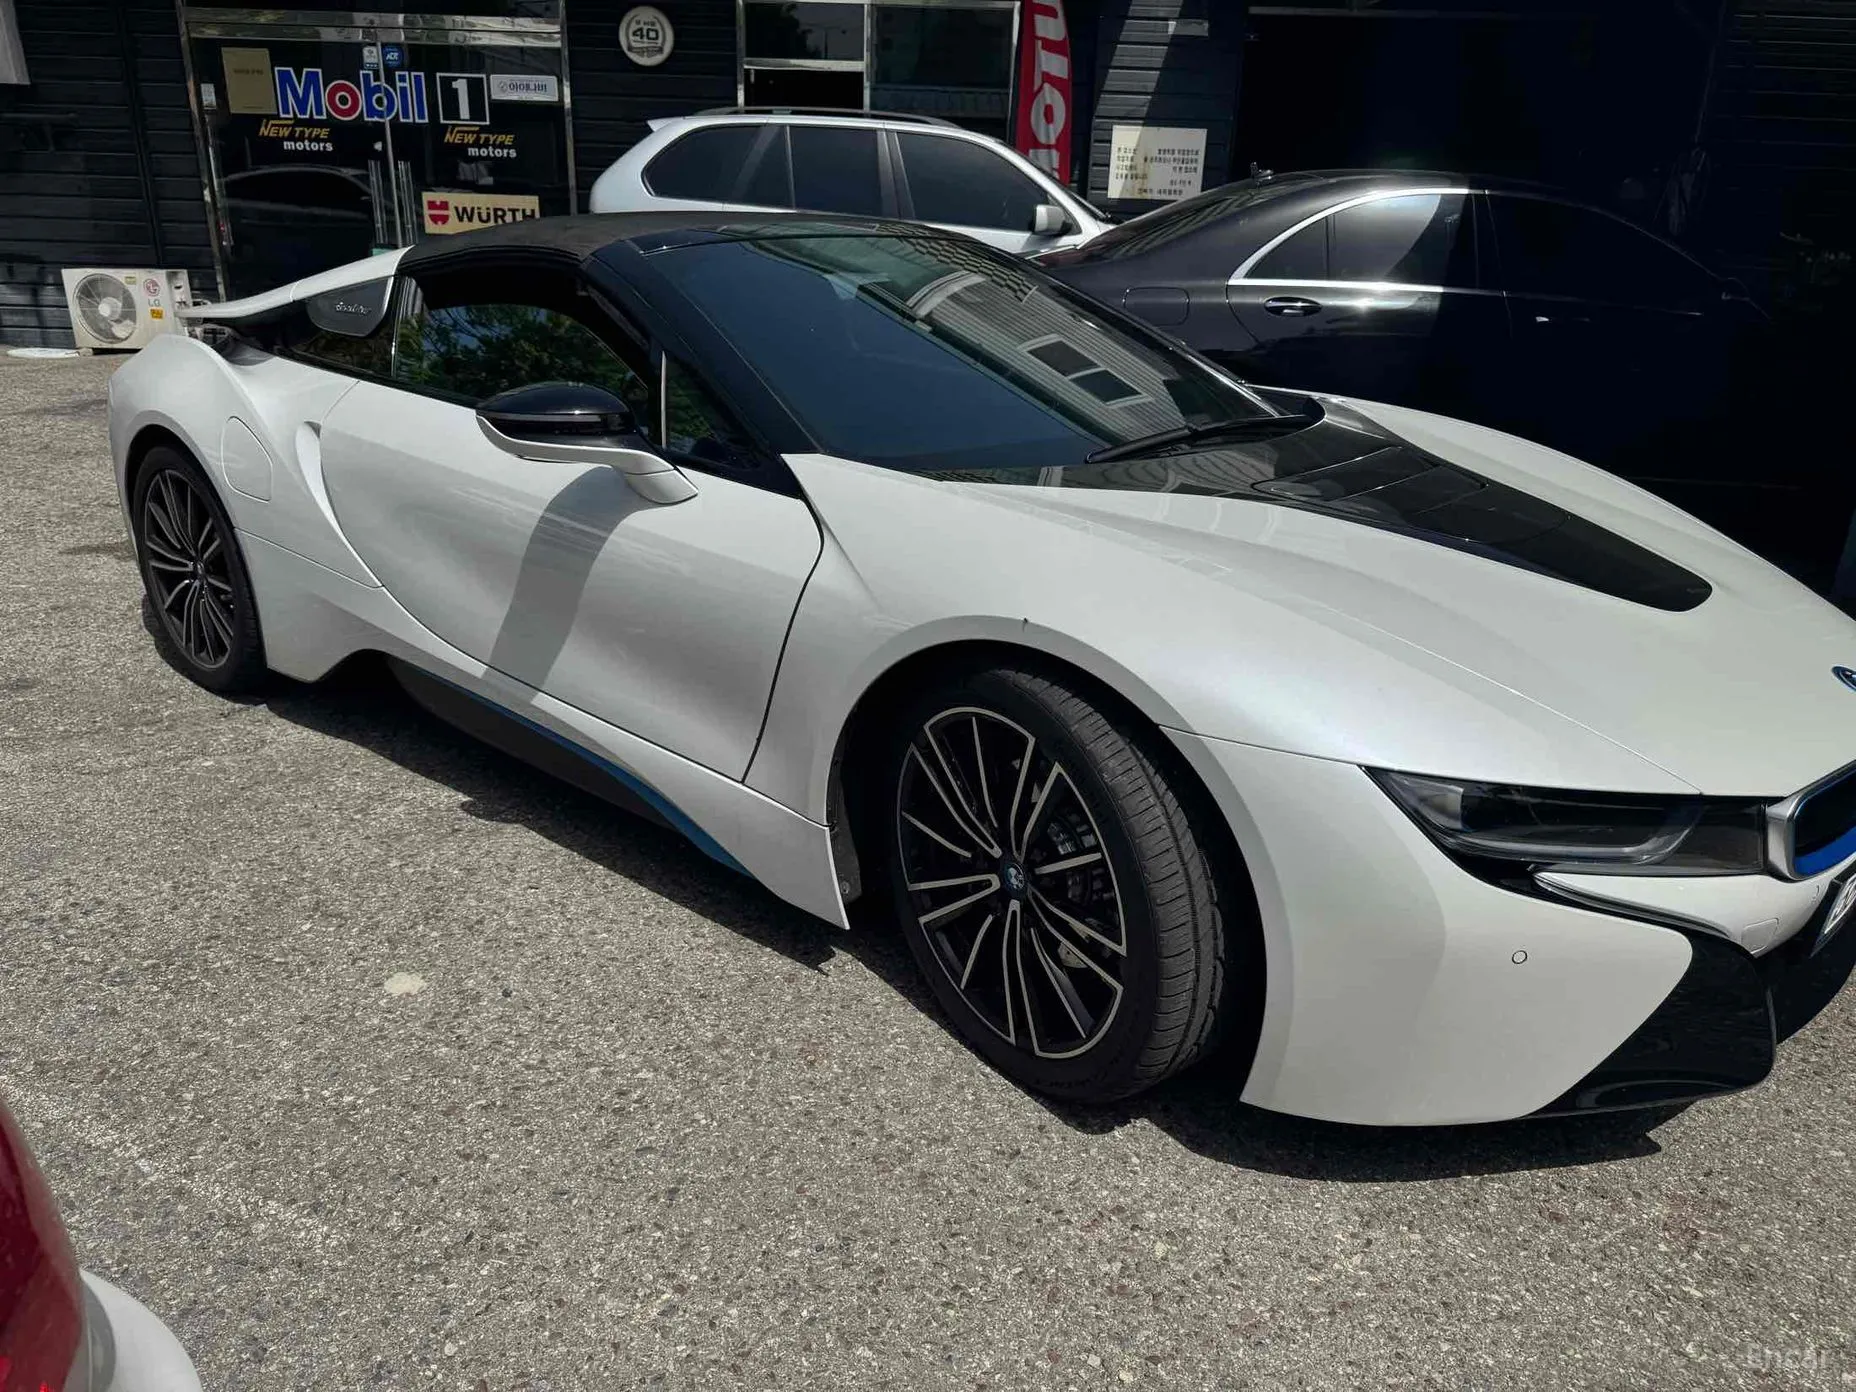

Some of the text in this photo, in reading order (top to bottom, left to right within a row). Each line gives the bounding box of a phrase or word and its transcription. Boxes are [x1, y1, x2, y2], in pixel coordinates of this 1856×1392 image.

[632, 27, 659, 40] 40
[274, 66, 429, 123] Mobil
[258, 119, 330, 139] NEW TYPE
[444, 125, 515, 145] NEW TYPE
[283, 139, 333, 152] motors
[467, 146, 517, 158] motors
